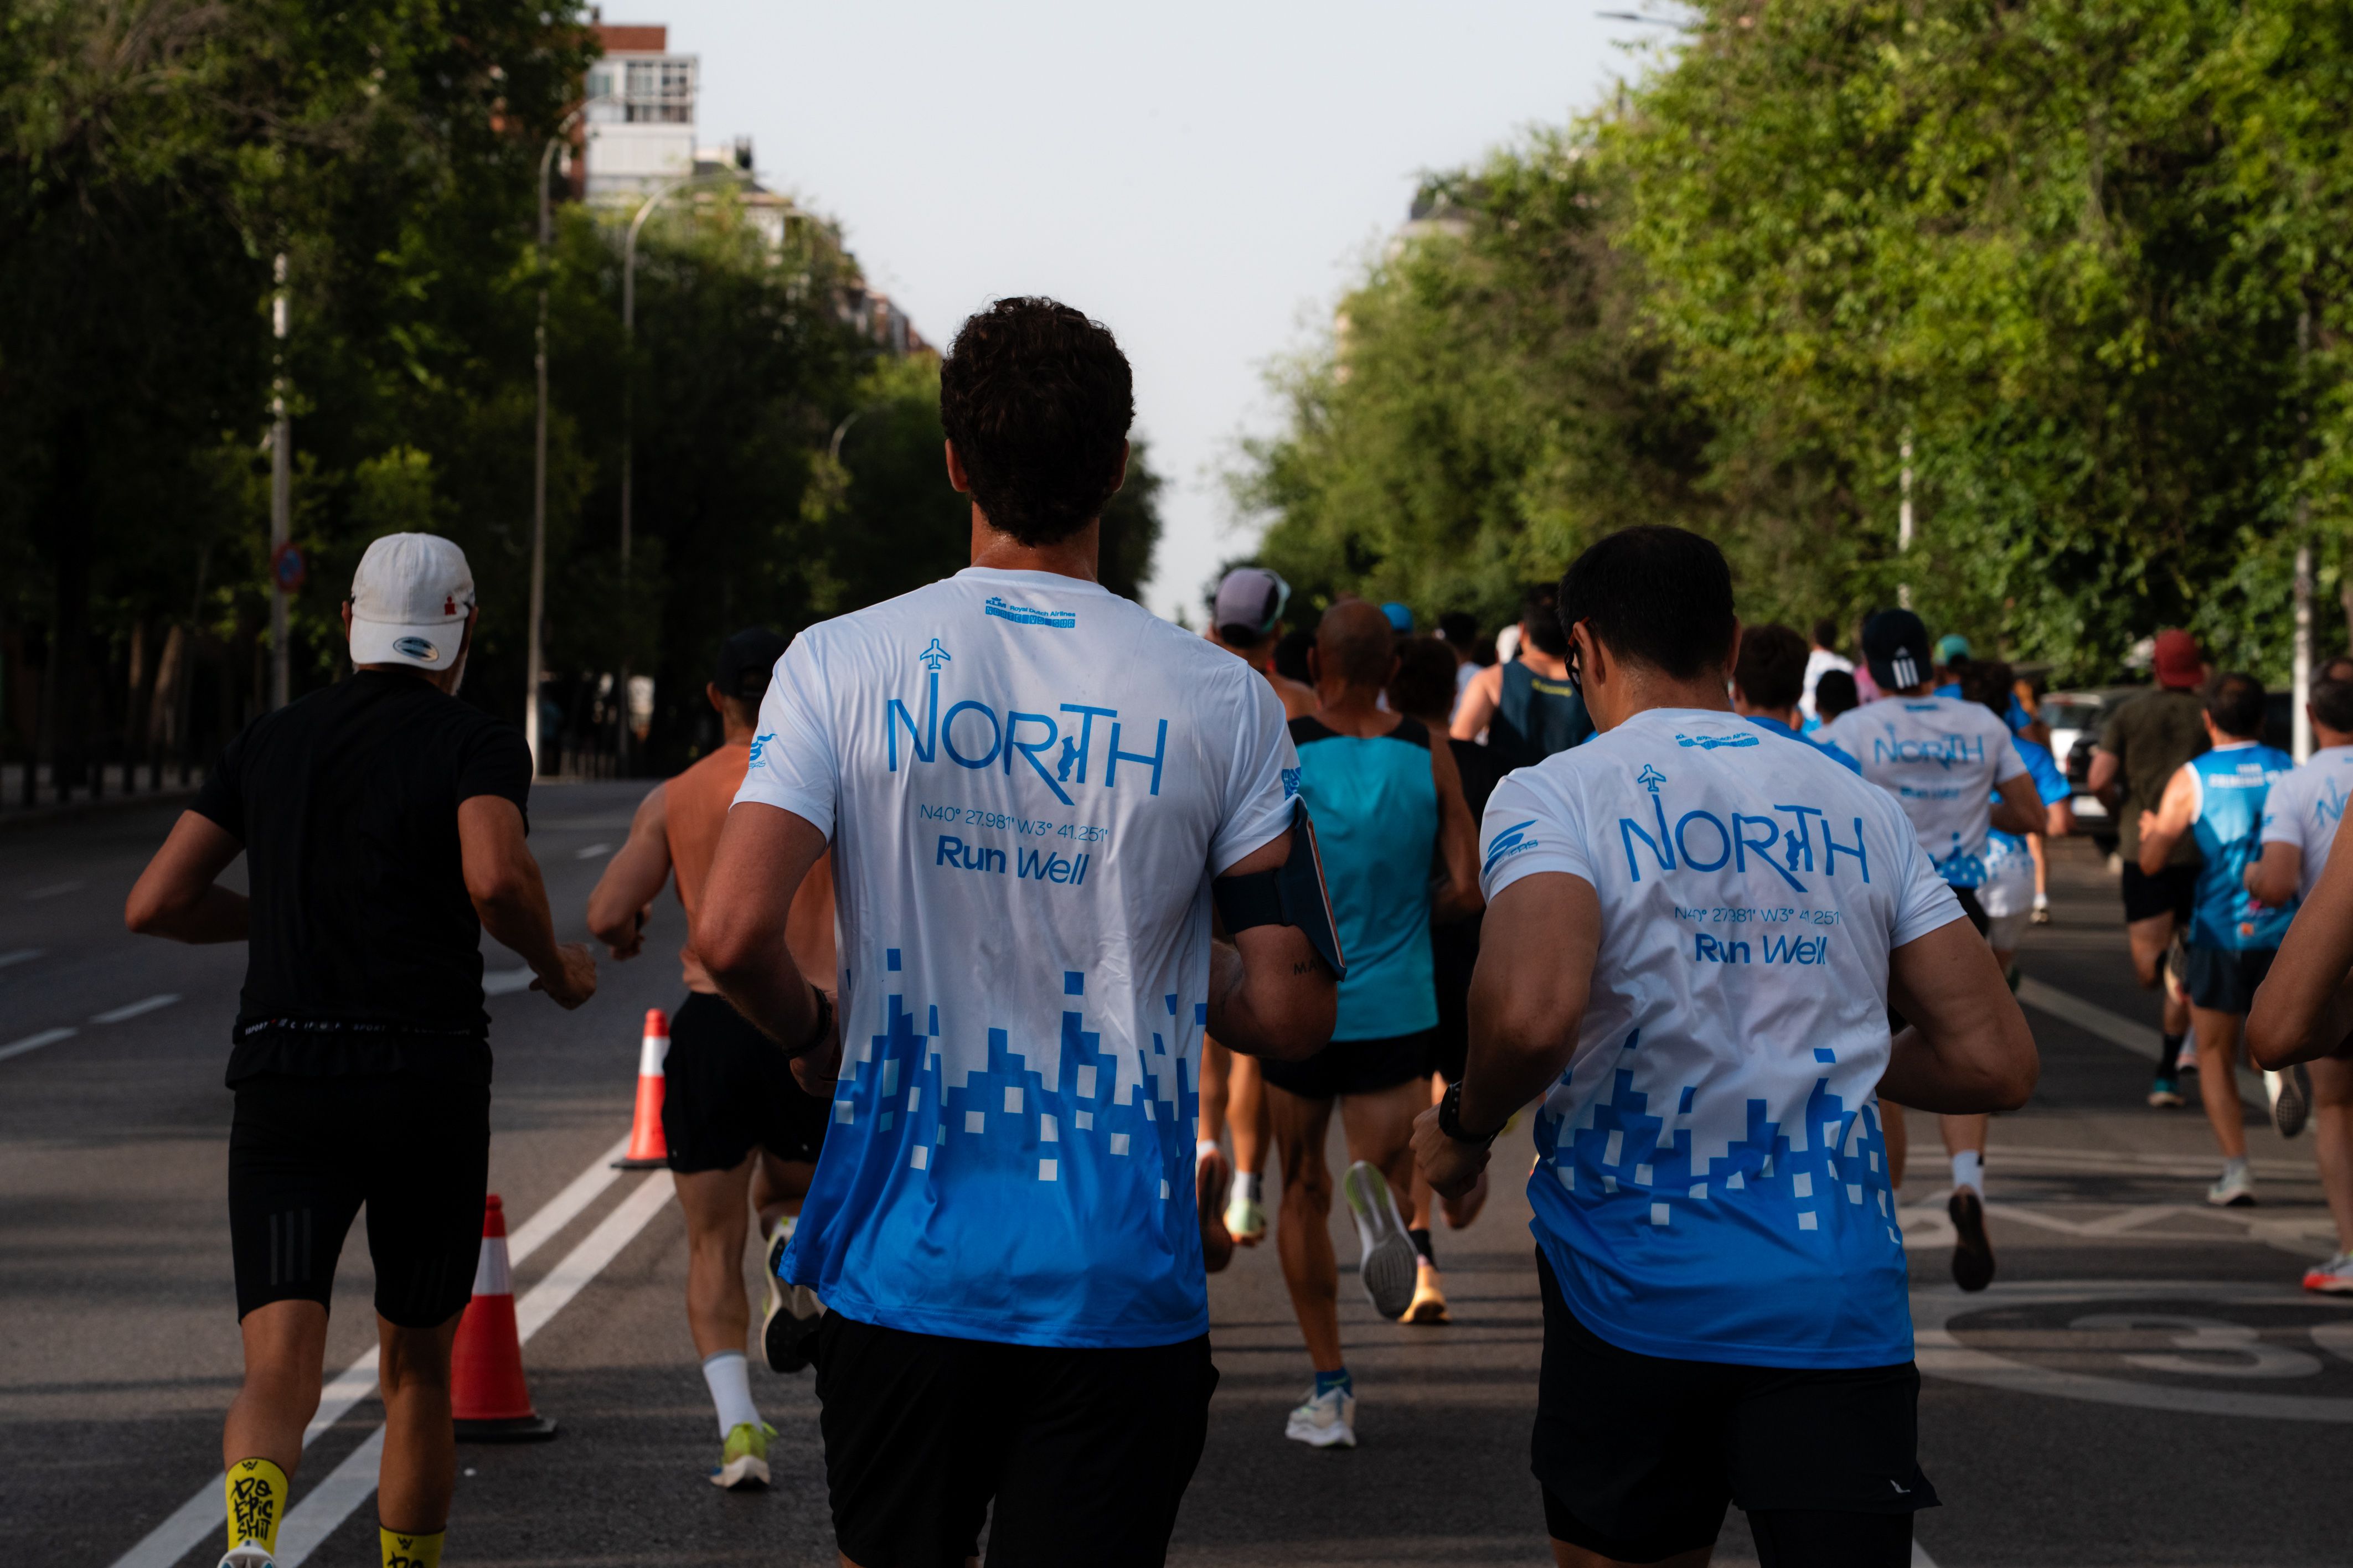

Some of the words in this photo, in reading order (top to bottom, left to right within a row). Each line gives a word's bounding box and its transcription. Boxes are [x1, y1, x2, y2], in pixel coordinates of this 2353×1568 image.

[985, 599, 1007, 608] KLM
[1029, 608, 1049, 617] Dutch
[887, 673, 1167, 805] NORTH
[1875, 729, 1985, 770] NORTH
[920, 804, 961, 822] N40°
[1018, 819, 1052, 836] W3°
[936, 835, 1007, 874] Run
[1018, 847, 1090, 885] Well
[1619, 795, 1870, 893] NORTH
[1695, 933, 1751, 964] Run
[1763, 935, 1827, 965] Well
